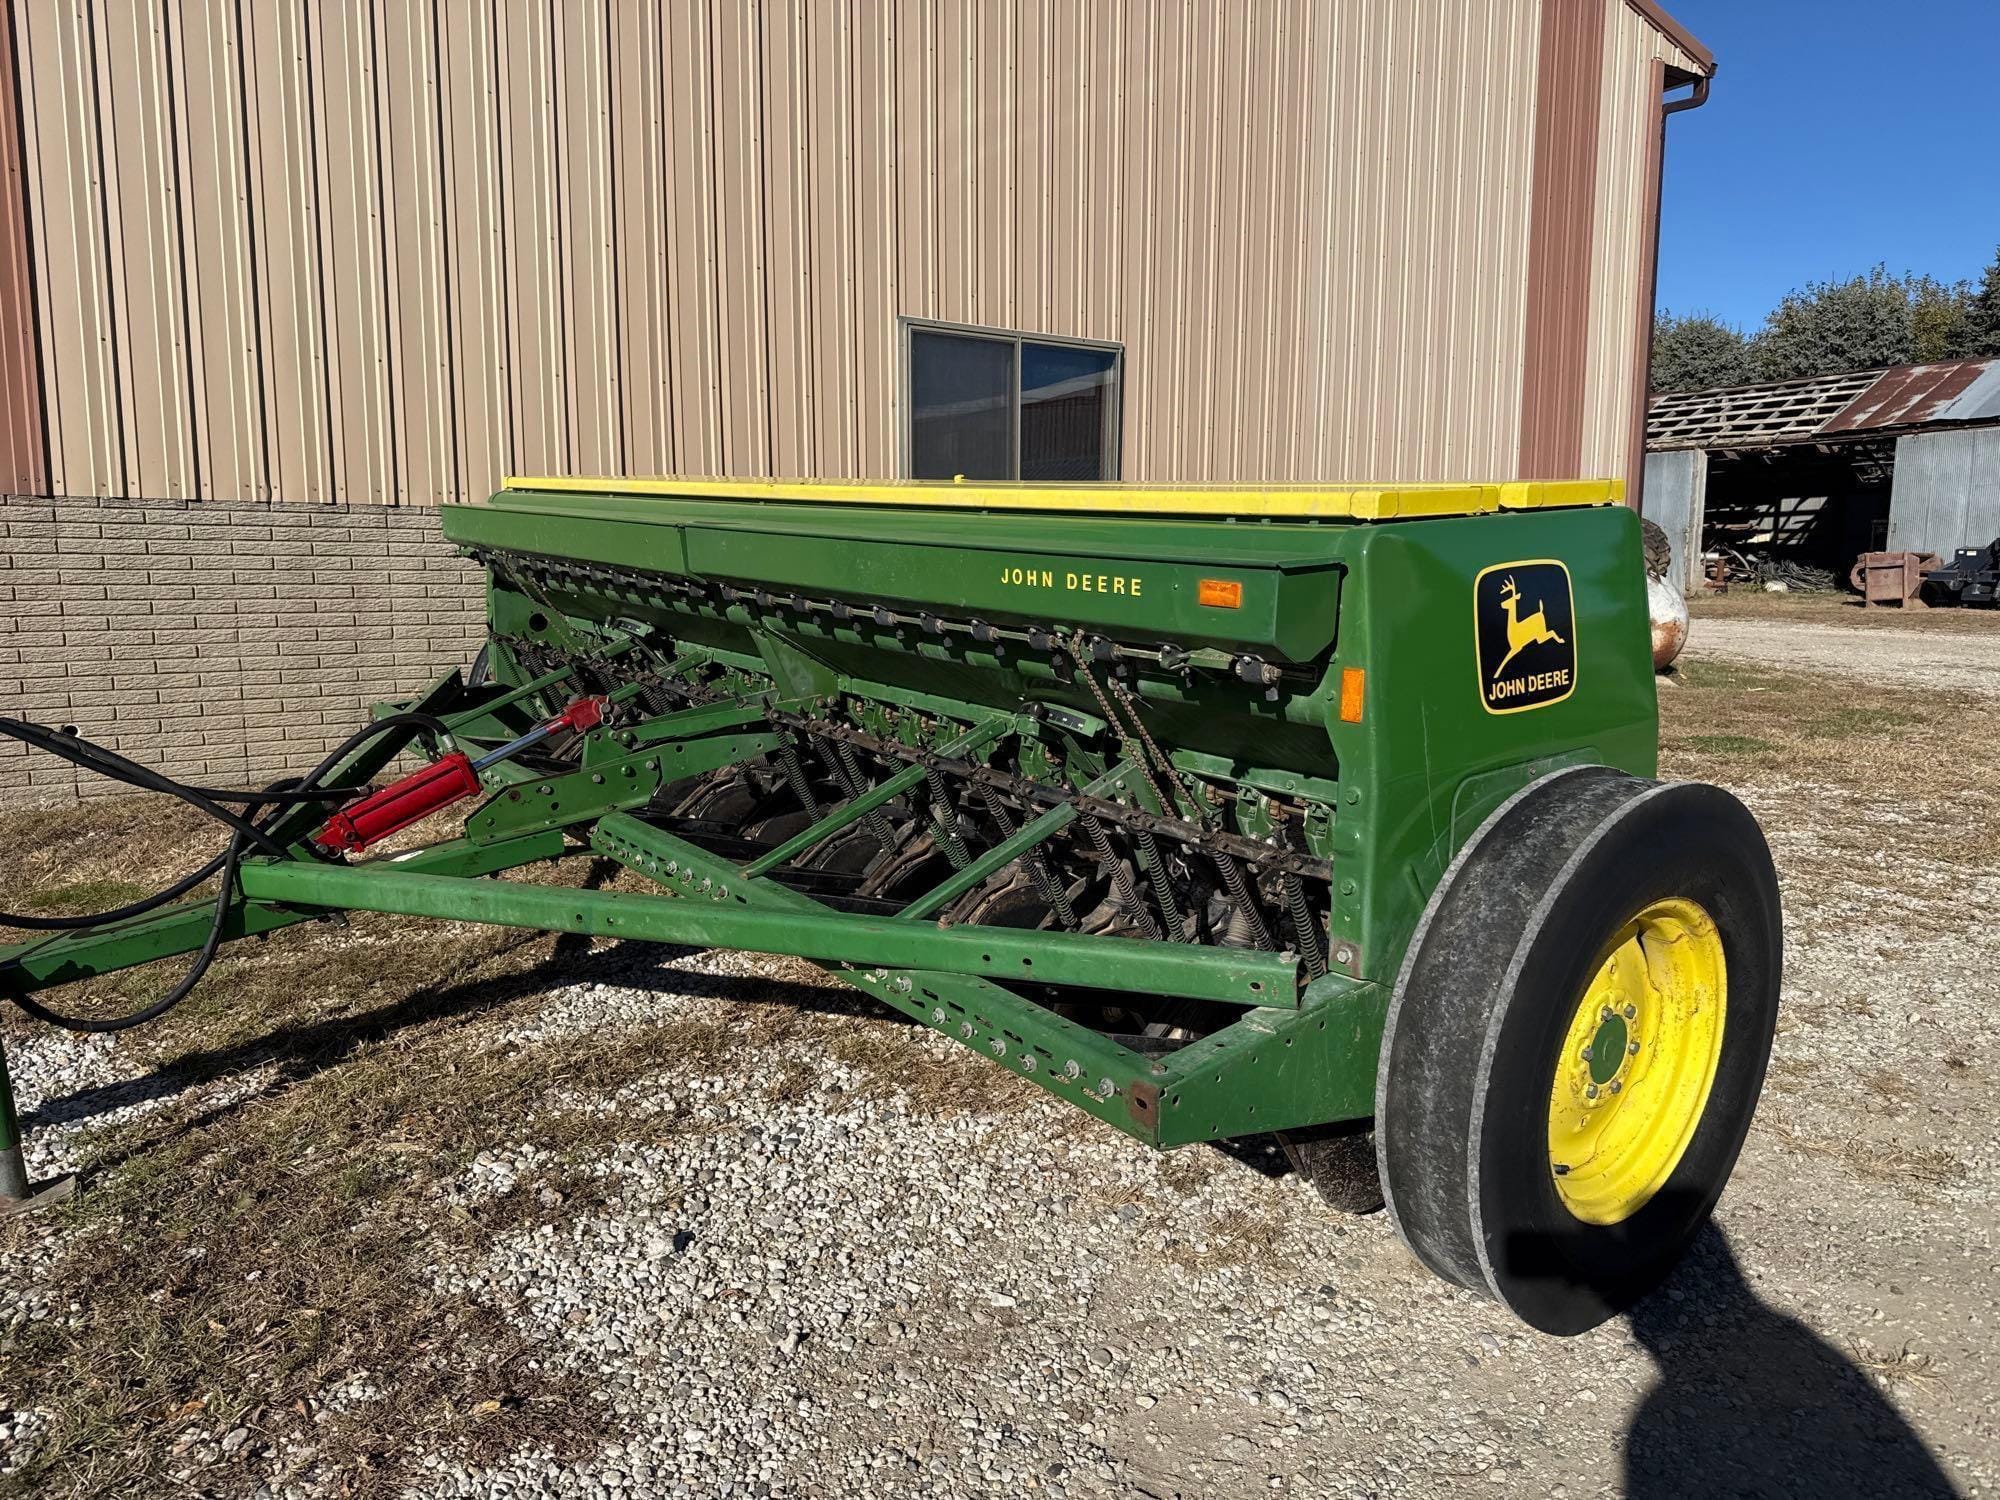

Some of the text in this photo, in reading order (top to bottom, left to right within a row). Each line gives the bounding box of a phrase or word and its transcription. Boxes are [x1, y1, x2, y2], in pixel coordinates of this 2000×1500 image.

[1001, 568, 1142, 596] JOHN DEERE
[1489, 669, 1570, 700] JOHN DEERE
